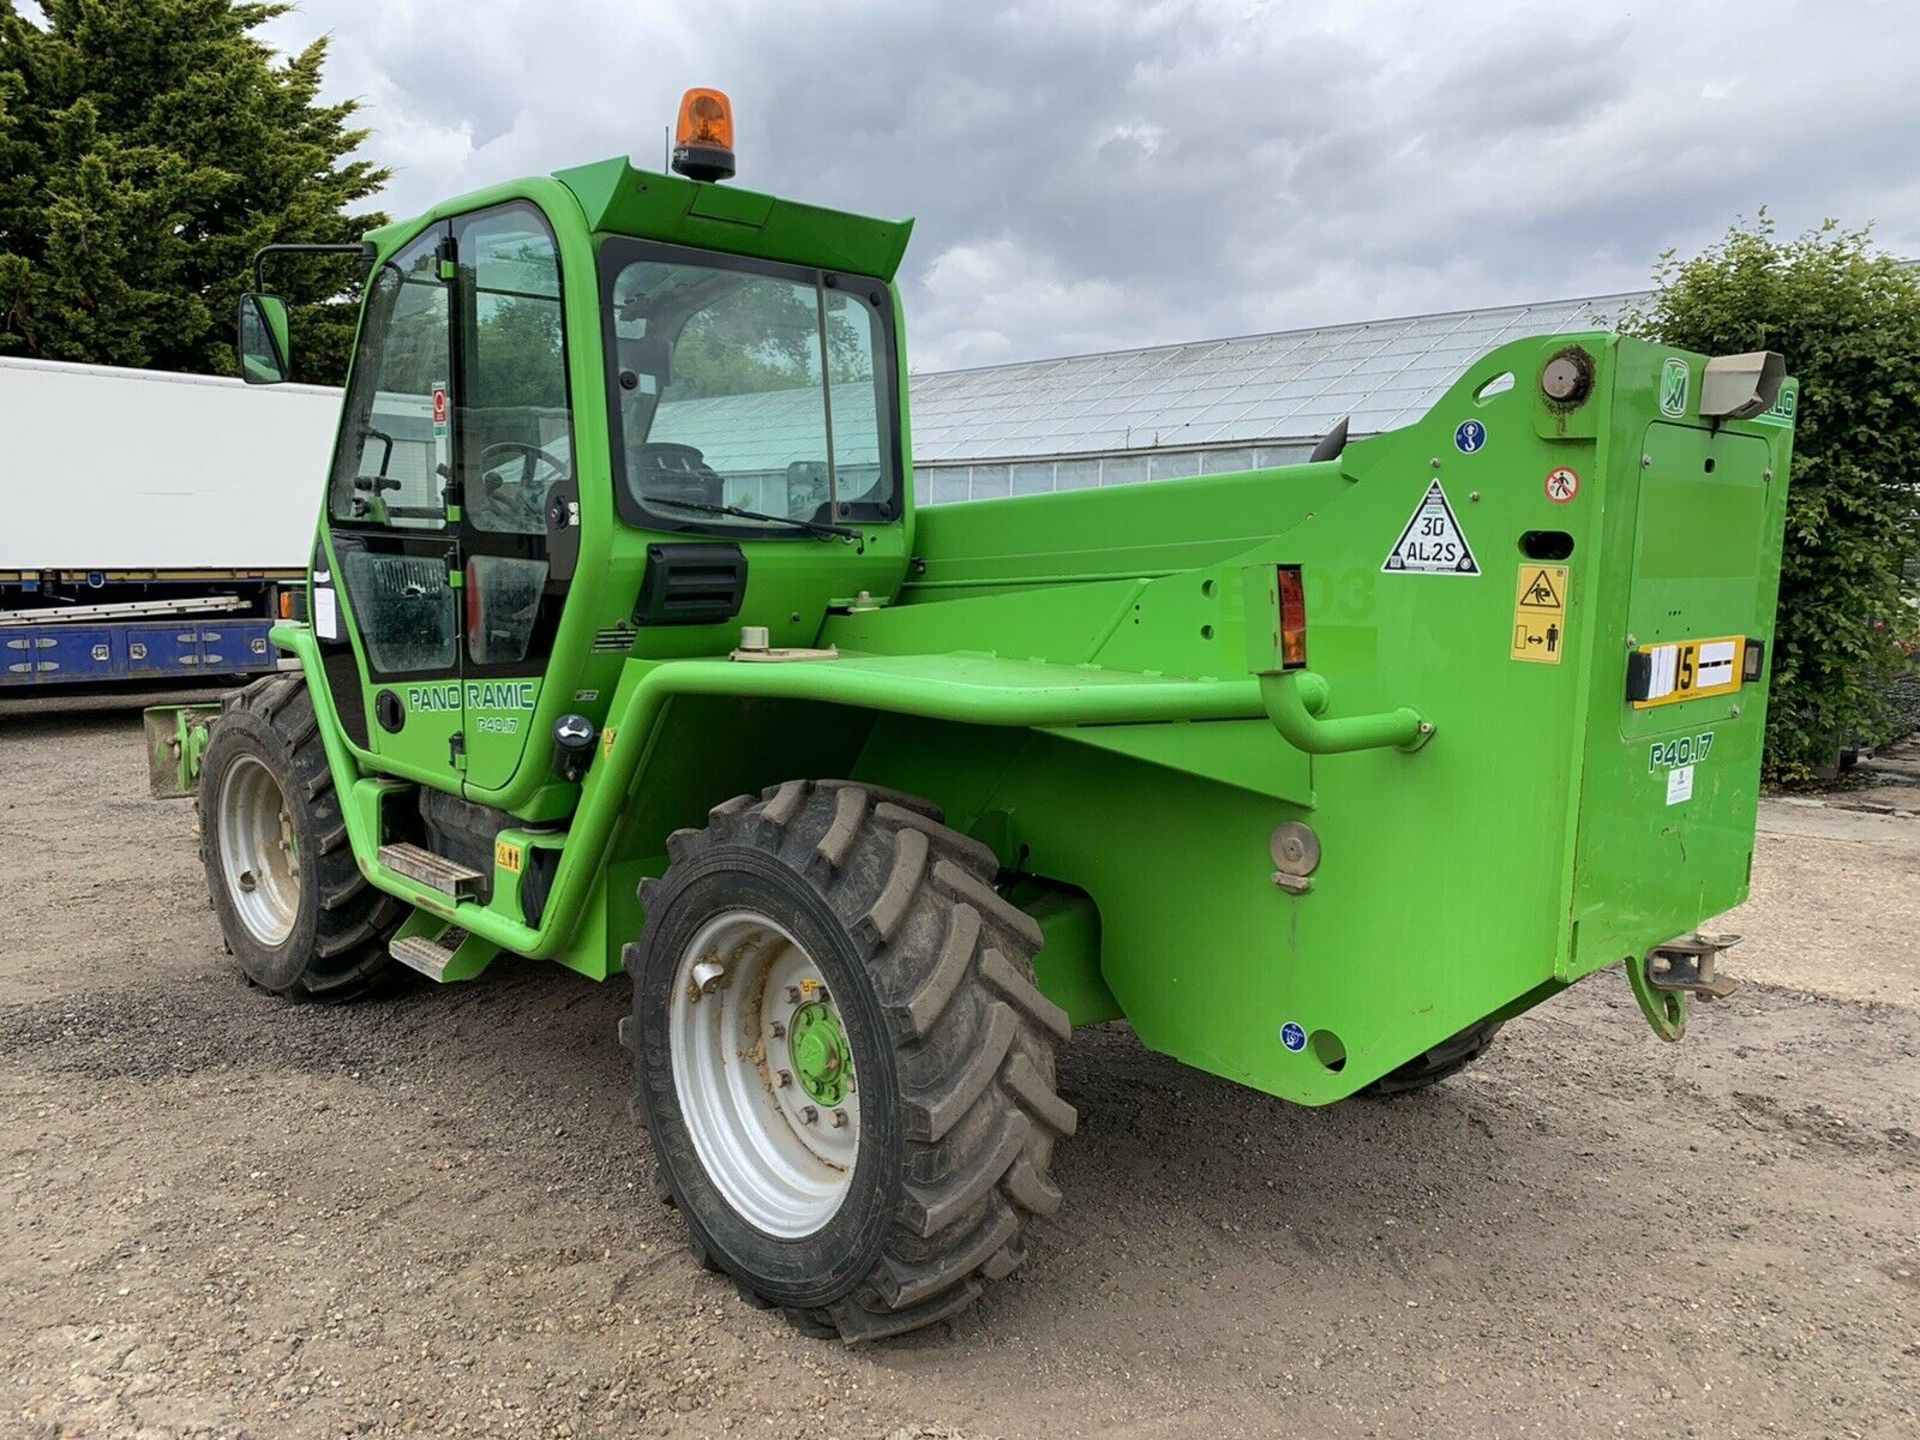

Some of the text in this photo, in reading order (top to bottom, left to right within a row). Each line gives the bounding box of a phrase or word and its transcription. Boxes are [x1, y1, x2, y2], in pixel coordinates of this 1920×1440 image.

[1421, 517, 1444, 536] 30
[1407, 542, 1456, 562] AL2S
[1675, 647, 1694, 691] 15
[477, 717, 518, 733] P40.17
[1649, 732, 1714, 773] P40.17
